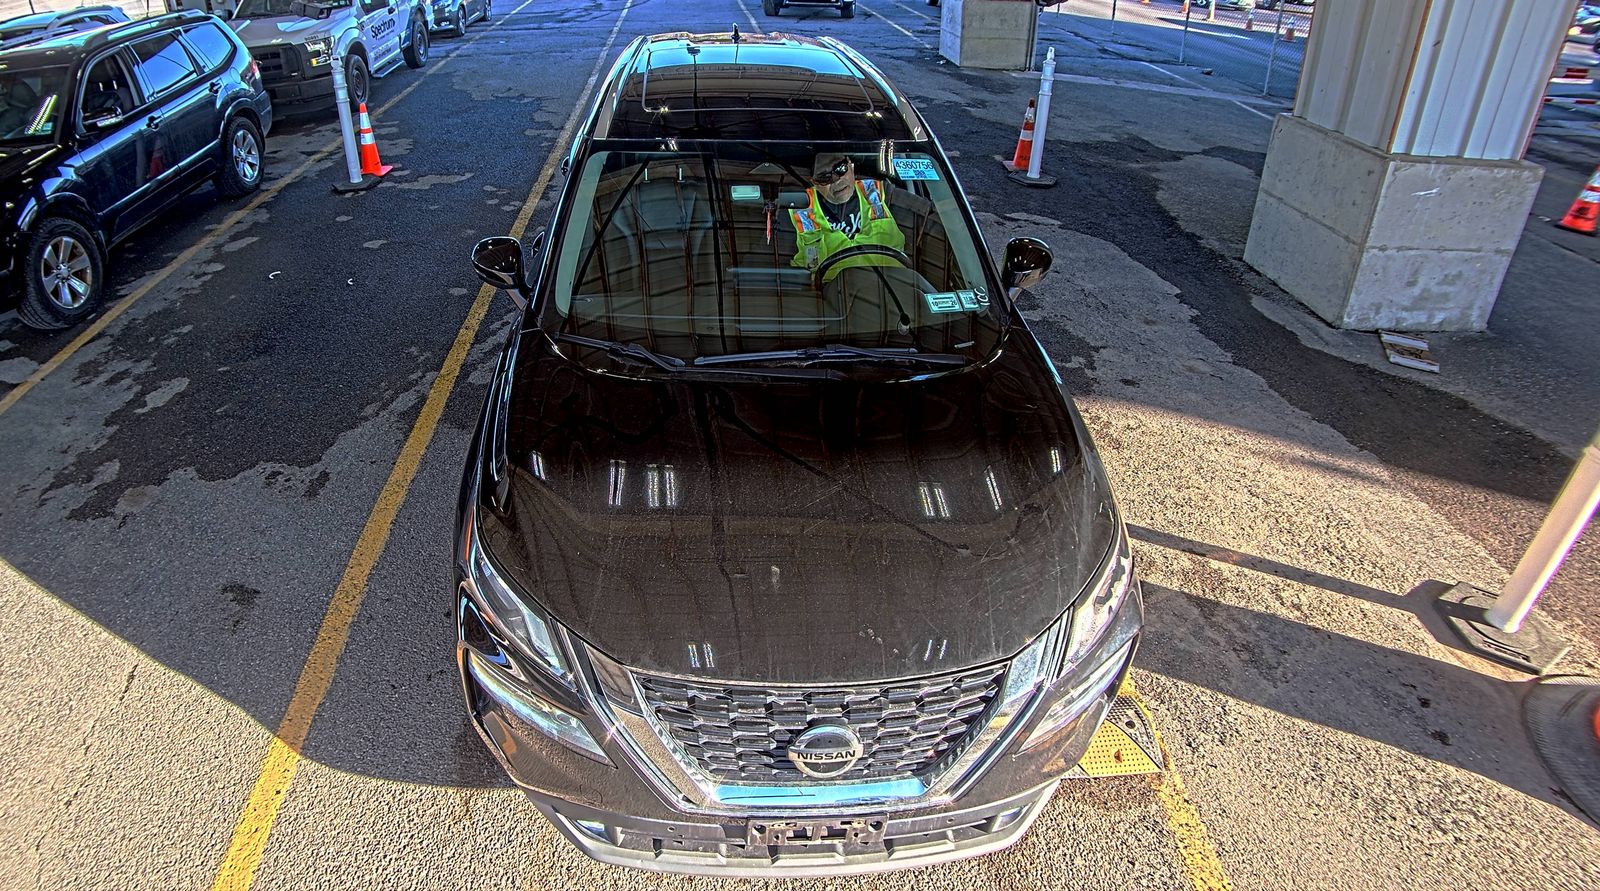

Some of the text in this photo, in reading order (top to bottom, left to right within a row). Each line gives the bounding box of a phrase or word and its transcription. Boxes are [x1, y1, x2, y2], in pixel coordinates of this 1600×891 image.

[370, 18, 395, 40] Spectrum
[896, 161, 934, 169] 4360756
[797, 750, 856, 760] NISSAN
